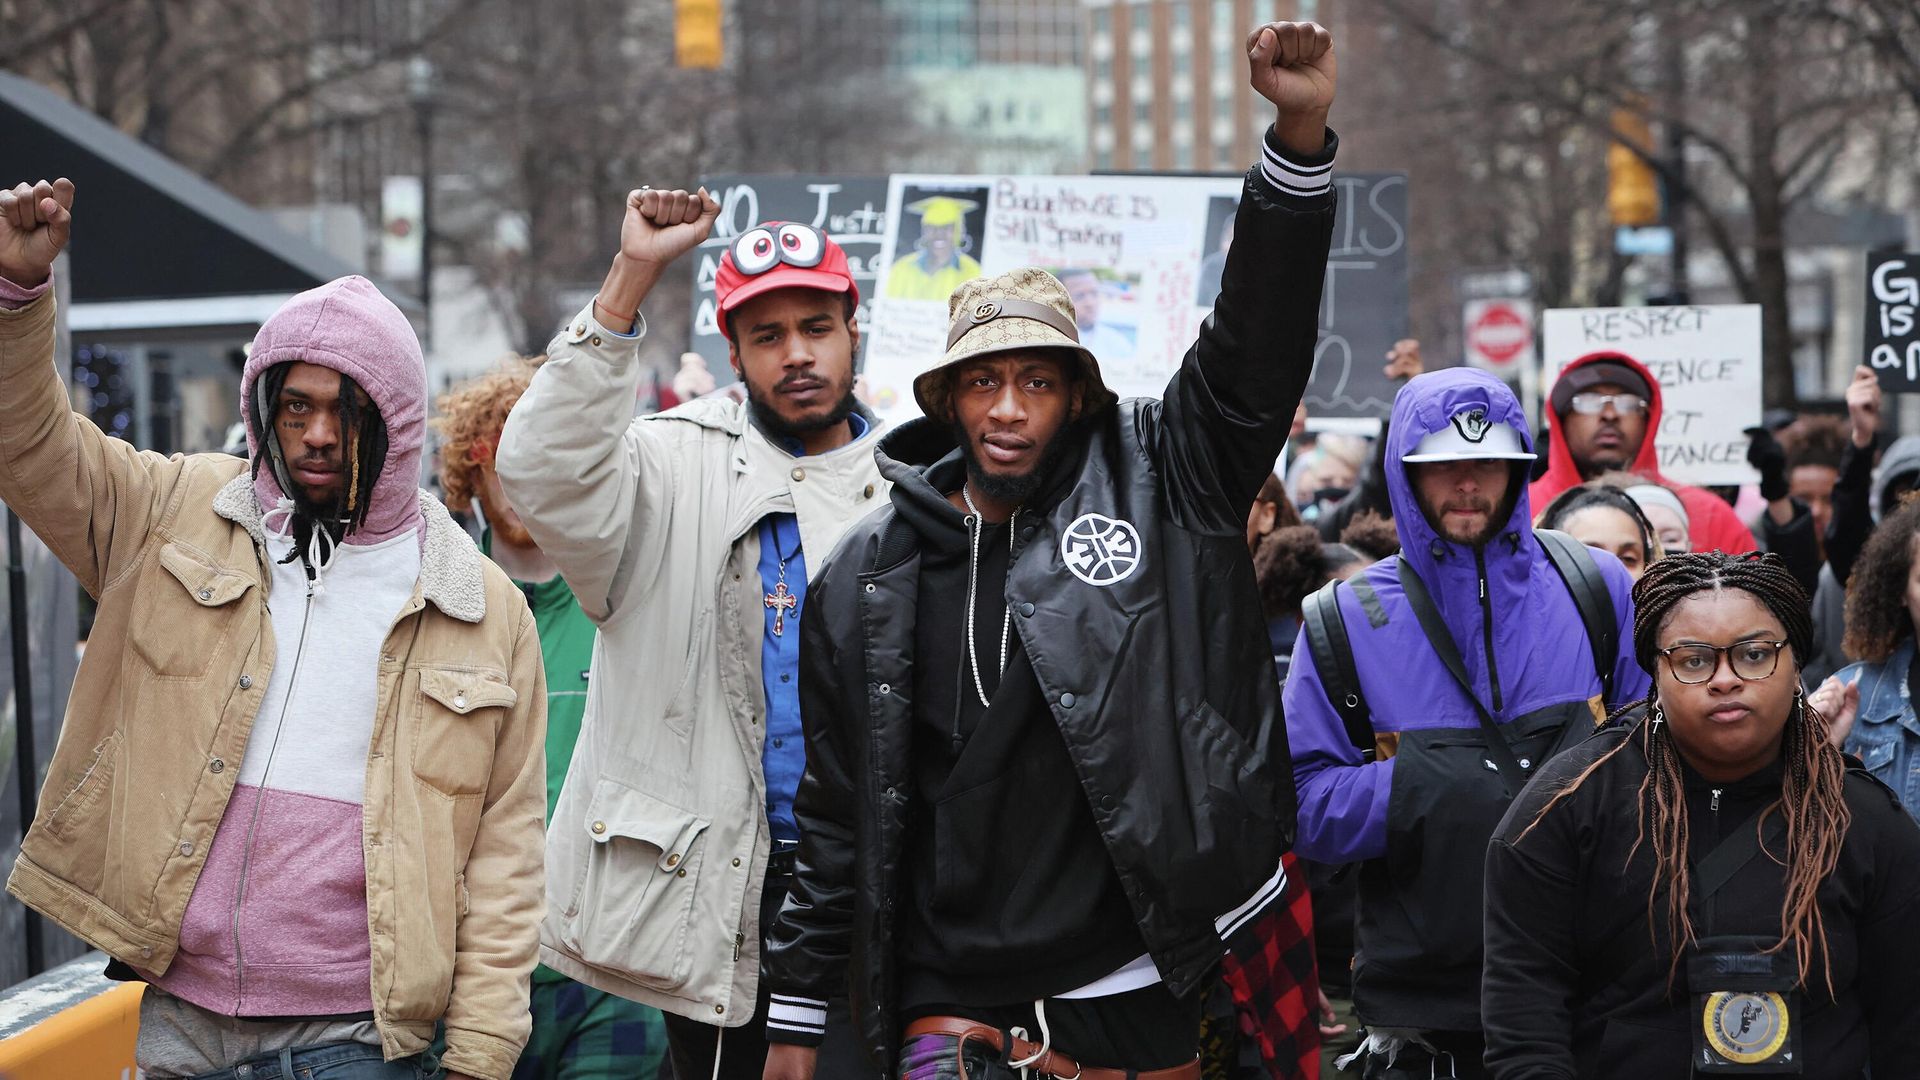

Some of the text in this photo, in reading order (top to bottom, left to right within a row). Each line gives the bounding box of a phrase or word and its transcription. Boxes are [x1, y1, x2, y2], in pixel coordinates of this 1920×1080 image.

[1581, 307, 1711, 342] RESPECT
[1880, 303, 1915, 338] is
[1662, 410, 1703, 436] CT
[1656, 441, 1750, 467] TANCE
